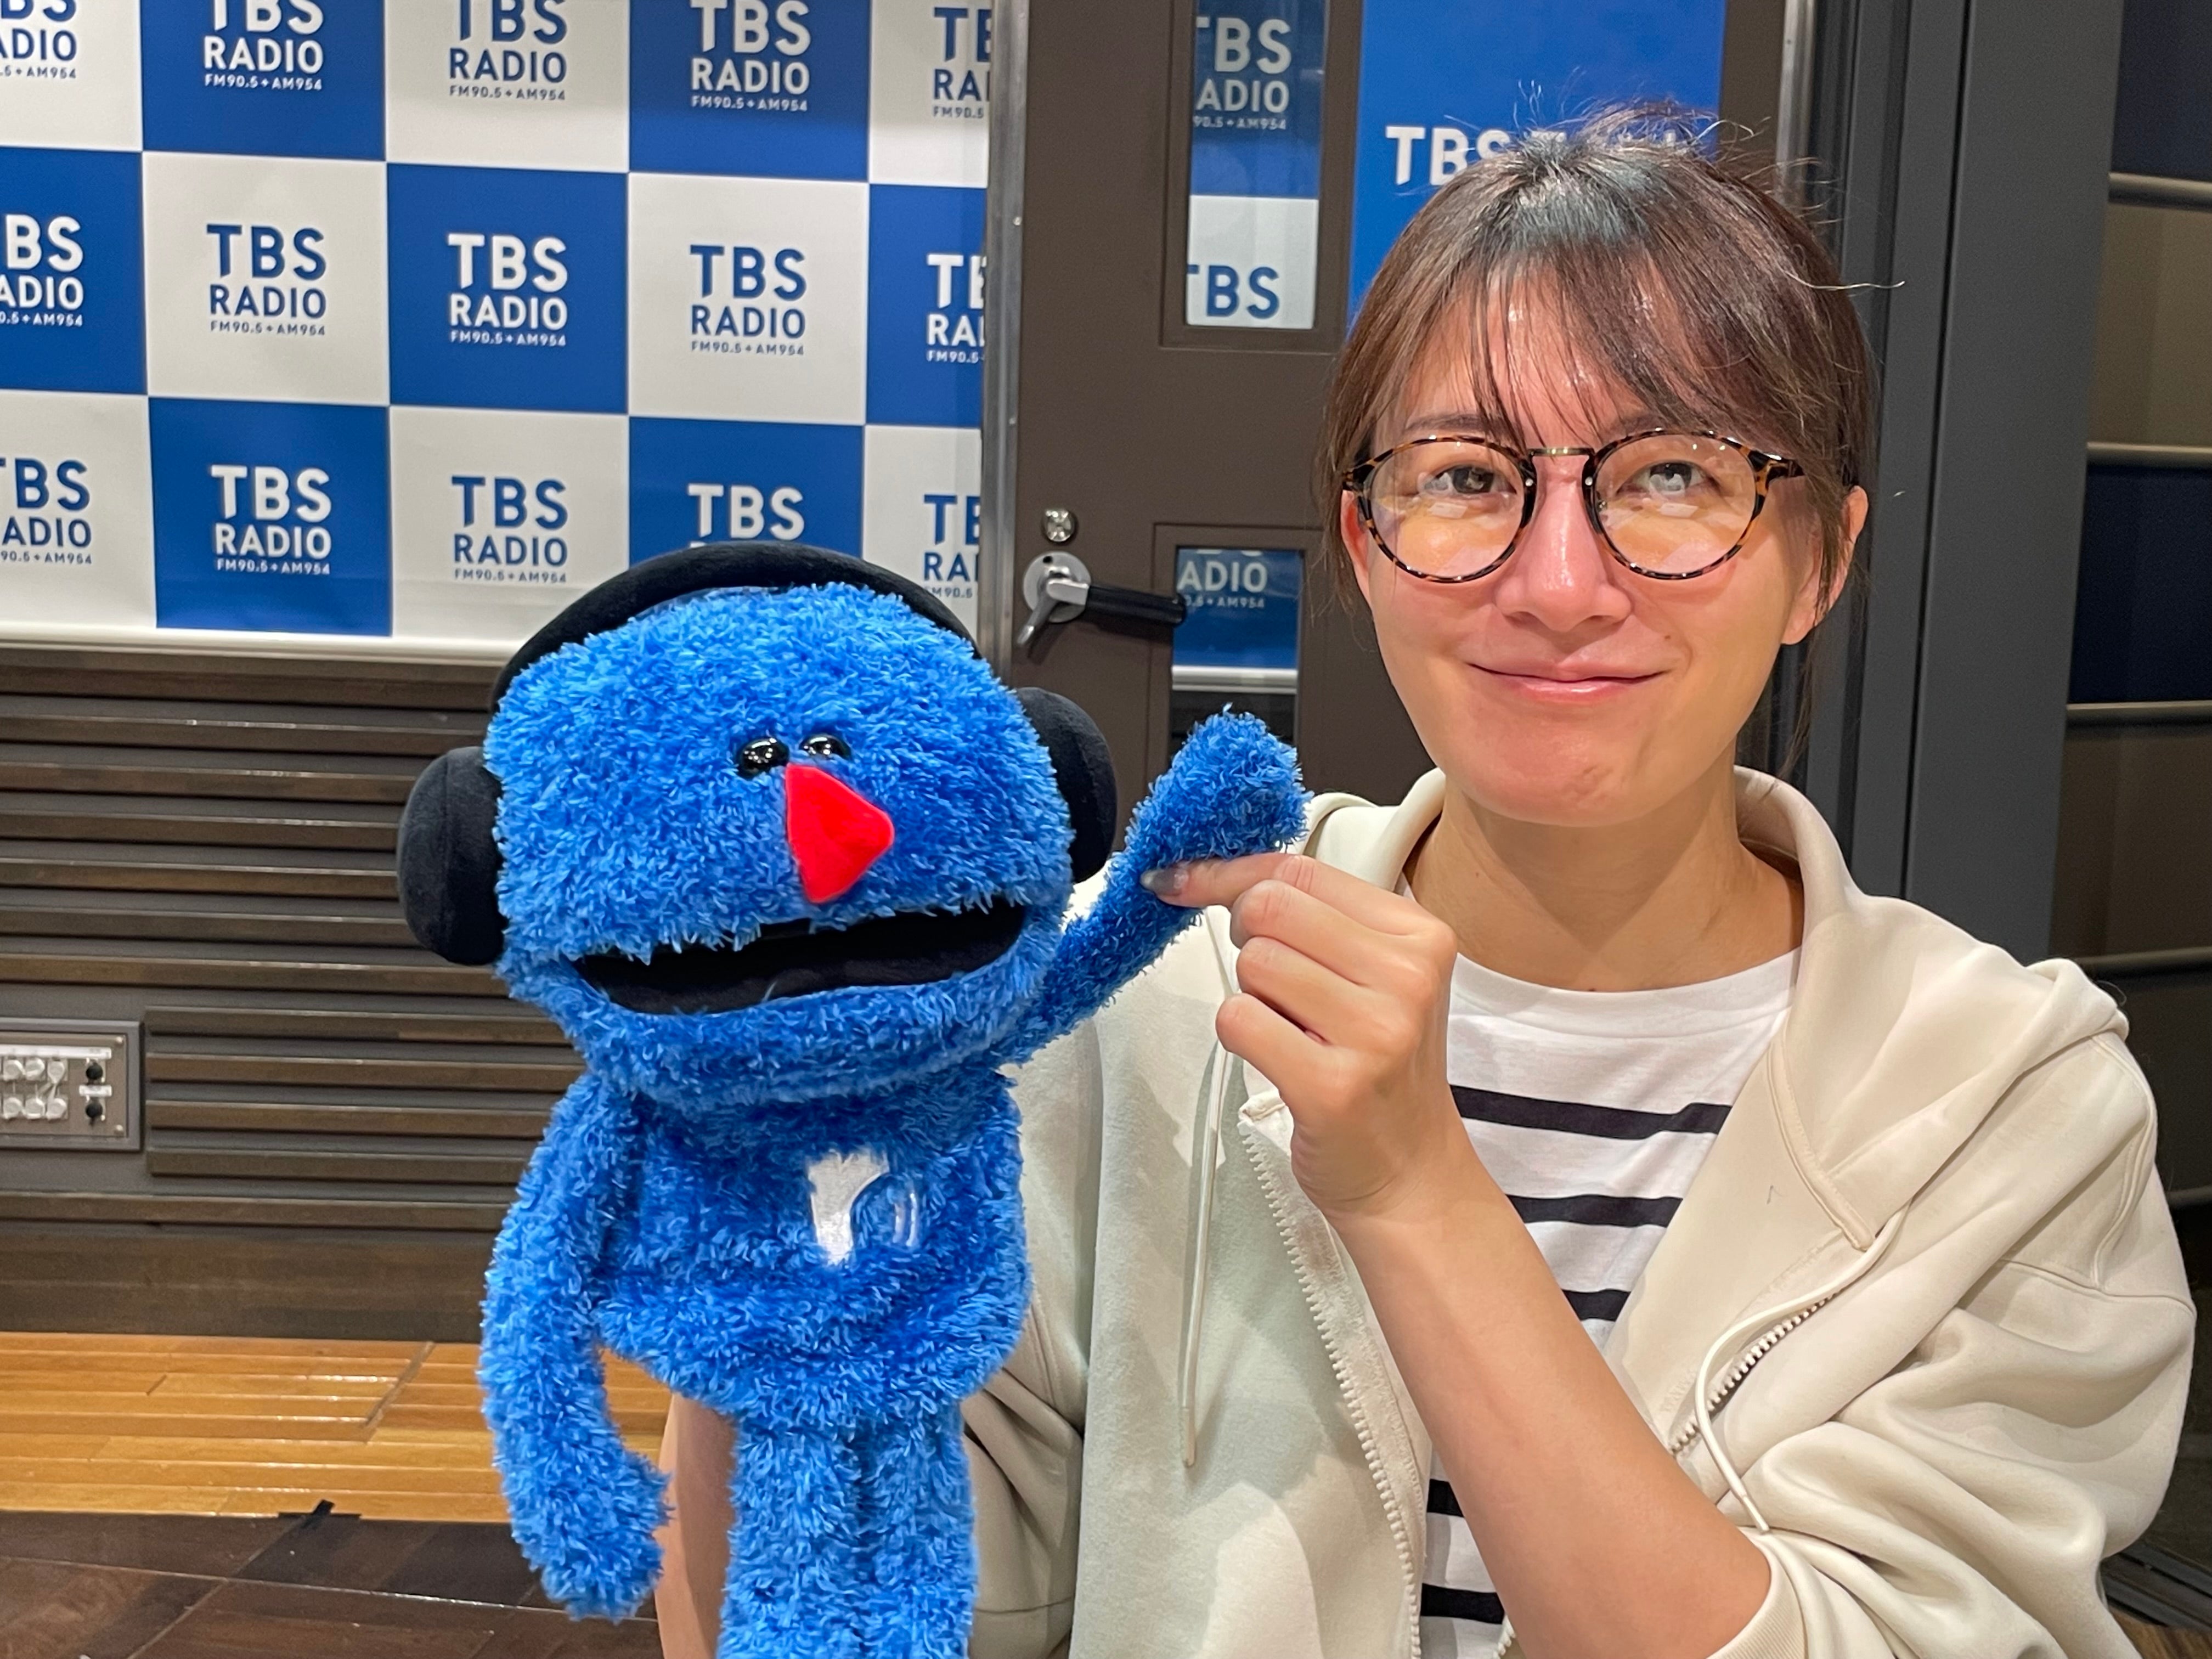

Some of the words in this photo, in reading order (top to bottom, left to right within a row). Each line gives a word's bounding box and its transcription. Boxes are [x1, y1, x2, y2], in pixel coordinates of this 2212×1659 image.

[690, 0, 811, 56] TBS
[204, 36, 323, 74] RADIO
[450, 47, 567, 83] RADIO
[692, 58, 810, 95] RADIO
[206, 224, 326, 281] TBS
[448, 234, 568, 292] TBS
[690, 245, 807, 302] TBS
[210, 284, 326, 319] RADIO
[450, 293, 567, 331] RADIO
[692, 305, 805, 339] RADIO
[0, 458, 90, 511] BS
[211, 465, 332, 522] TBS
[452, 476, 568, 531] TBS
[688, 483, 804, 540] TBS
[216, 523, 331, 560] RADIO
[454, 534, 567, 567] RADIO
